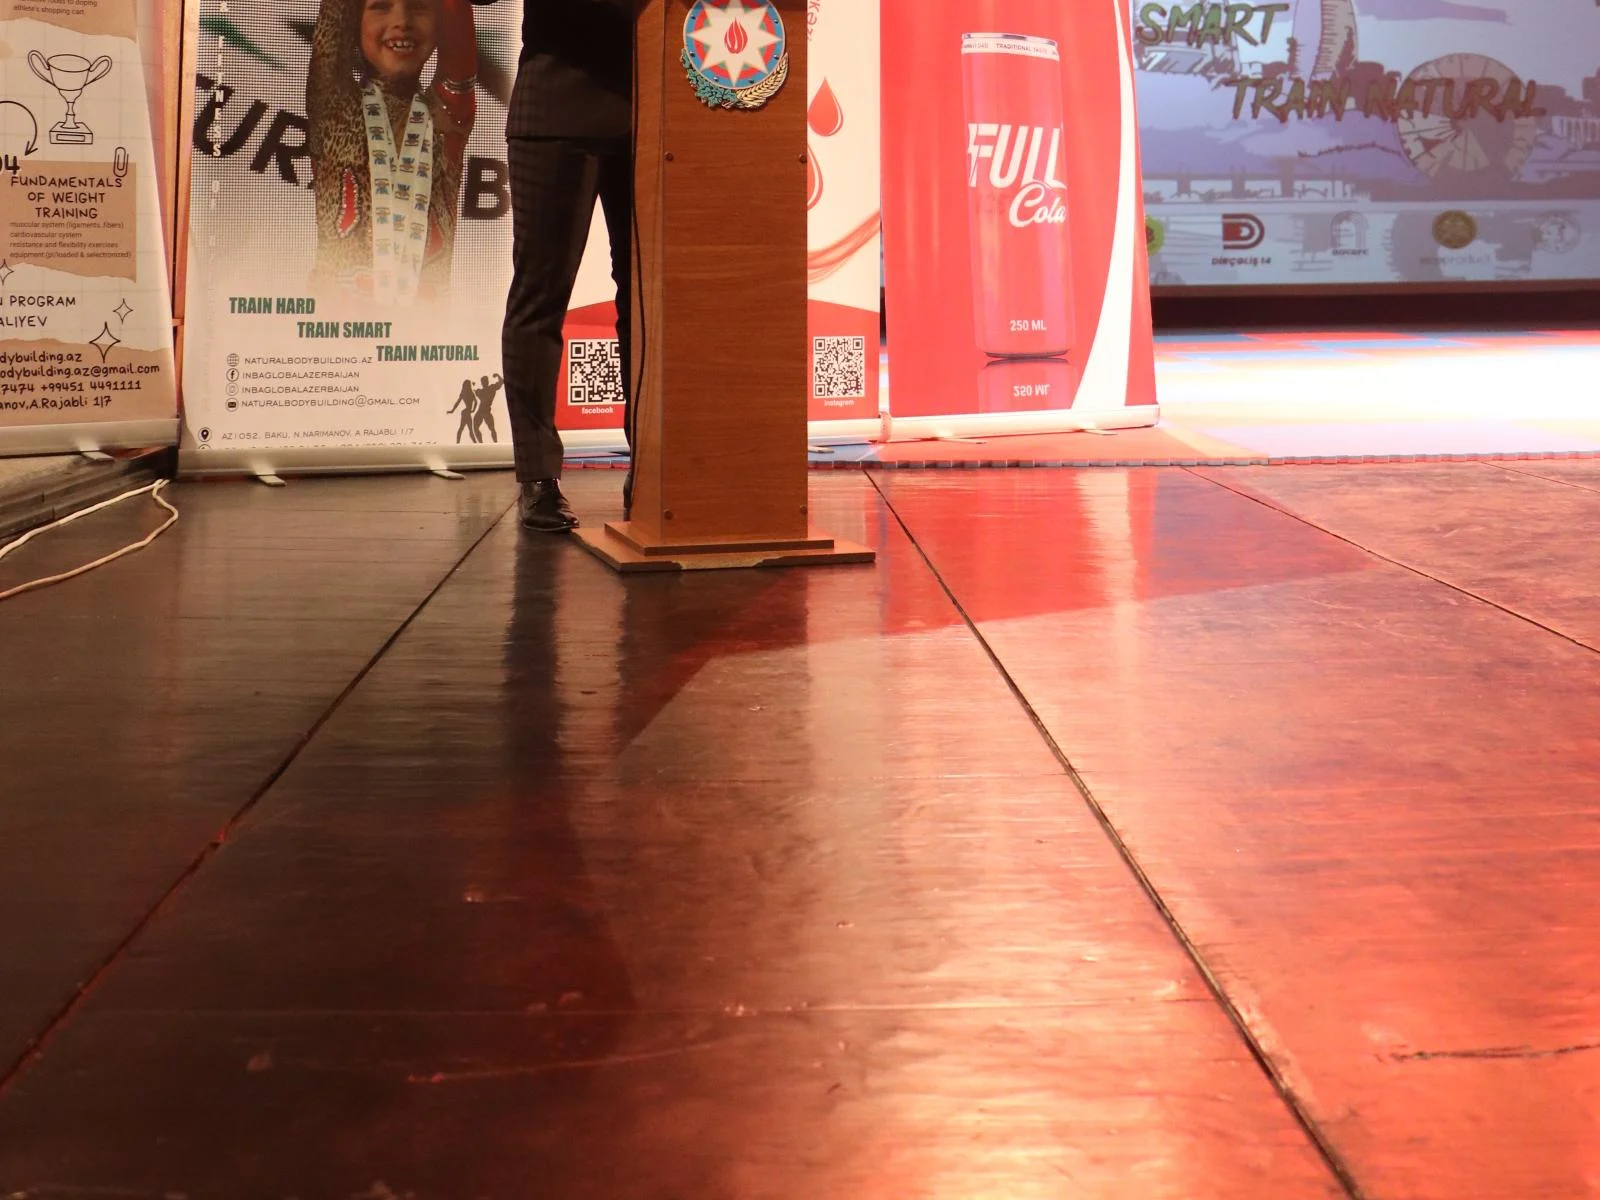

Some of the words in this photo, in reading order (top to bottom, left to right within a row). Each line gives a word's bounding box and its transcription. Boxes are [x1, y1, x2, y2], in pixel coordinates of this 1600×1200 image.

[42, 6, 70, 15] shopping
[1135, 2, 1289, 48] SMART
[1225, 77, 1352, 123] TRAIN
[1362, 77, 1547, 124] NATURAL
[967, 123, 1067, 190] FULL
[0, 154, 20, 175] 4
[10, 175, 122, 188] FUNDAMENTALS
[28, 192, 45, 203] OF
[52, 192, 106, 203] WEIGHT
[1009, 182, 1067, 228] Cola
[35, 207, 98, 219] TRAINING
[10, 295, 76, 307] PROGRAM
[229, 297, 272, 314] TRAIN
[276, 298, 315, 314] HARD
[297, 321, 339, 338] TRAIN
[343, 321, 392, 338] SMART
[1010, 320, 1029, 332] 250
[1031, 320, 1047, 331] ML
[376, 345, 417, 361] TRAIN
[420, 345, 479, 361] NATURAL
[244, 356, 373, 365] NATURALBODYBUILDING.AZ
[242, 371, 360, 379] INBAGLOBALAZERBAIJAN
[1, 384, 35, 395] 7474
[41, 381, 84, 393] +99451
[90, 380, 142, 391] 4491111
[242, 385, 360, 394] INBAGLOBALAZERBAIJAN
[241, 395, 420, 408] NATURALBODYBUILDING@GMAIL.COM
[581, 406, 614, 415] facebook
